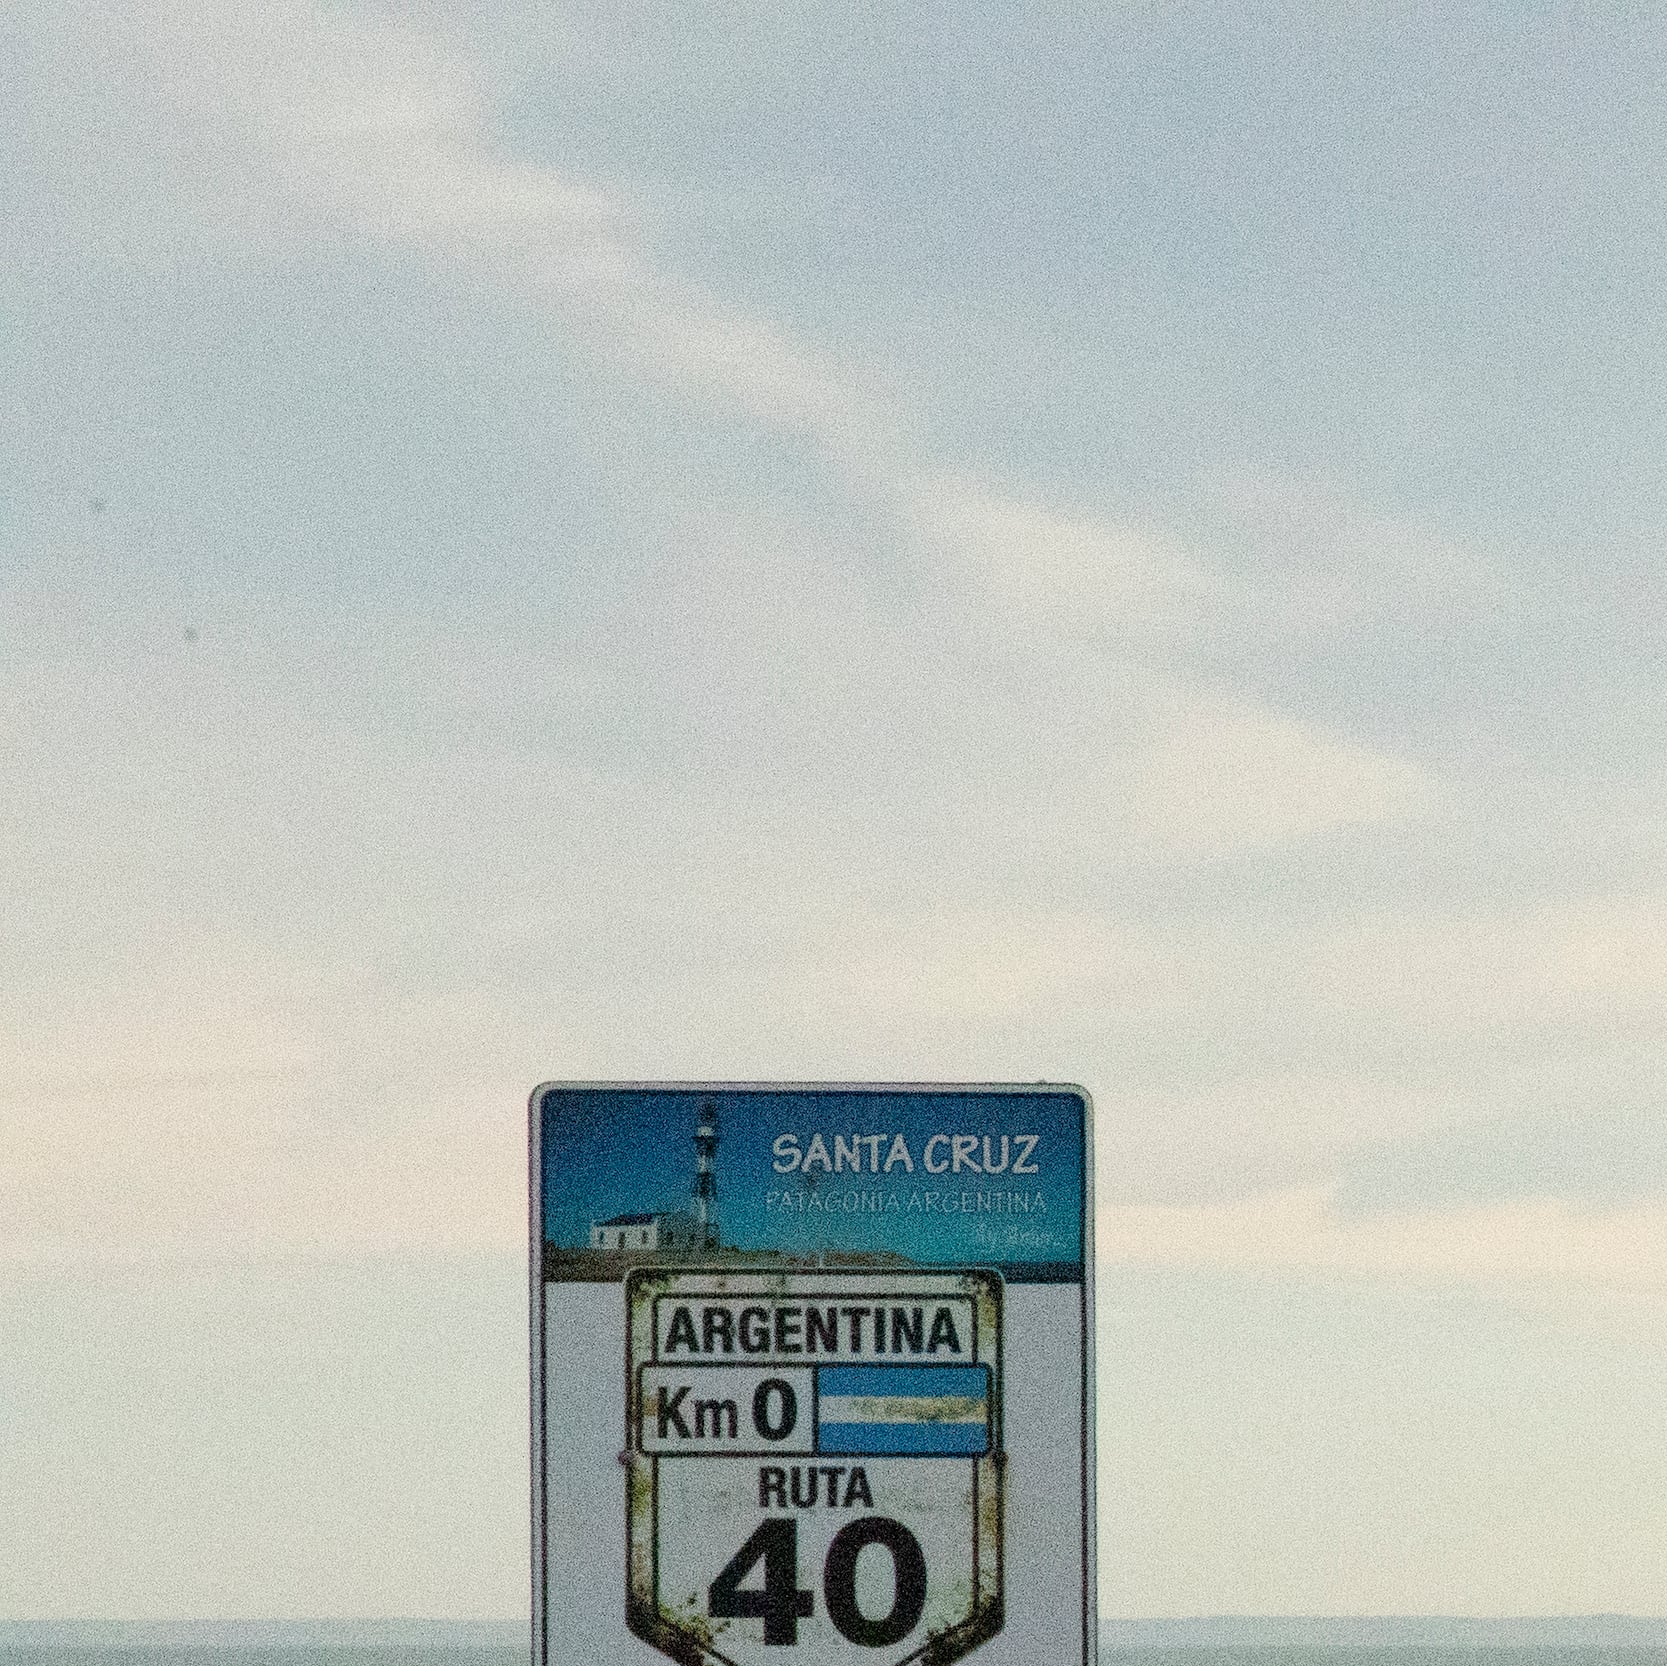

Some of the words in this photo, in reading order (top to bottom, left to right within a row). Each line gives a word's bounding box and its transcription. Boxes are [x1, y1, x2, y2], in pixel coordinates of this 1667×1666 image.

[771, 1133, 914, 1173] SANTA
[923, 1135, 1040, 1173] CRUZ
[765, 1190, 900, 1212] PATAGONIA
[906, 1191, 1048, 1213] ARGENTINA
[664, 1306, 963, 1354] ARGENTINA
[657, 1386, 738, 1439] Km
[752, 1378, 798, 1440] 0
[759, 1466, 875, 1508] RUTA
[708, 1516, 928, 1648] 40
